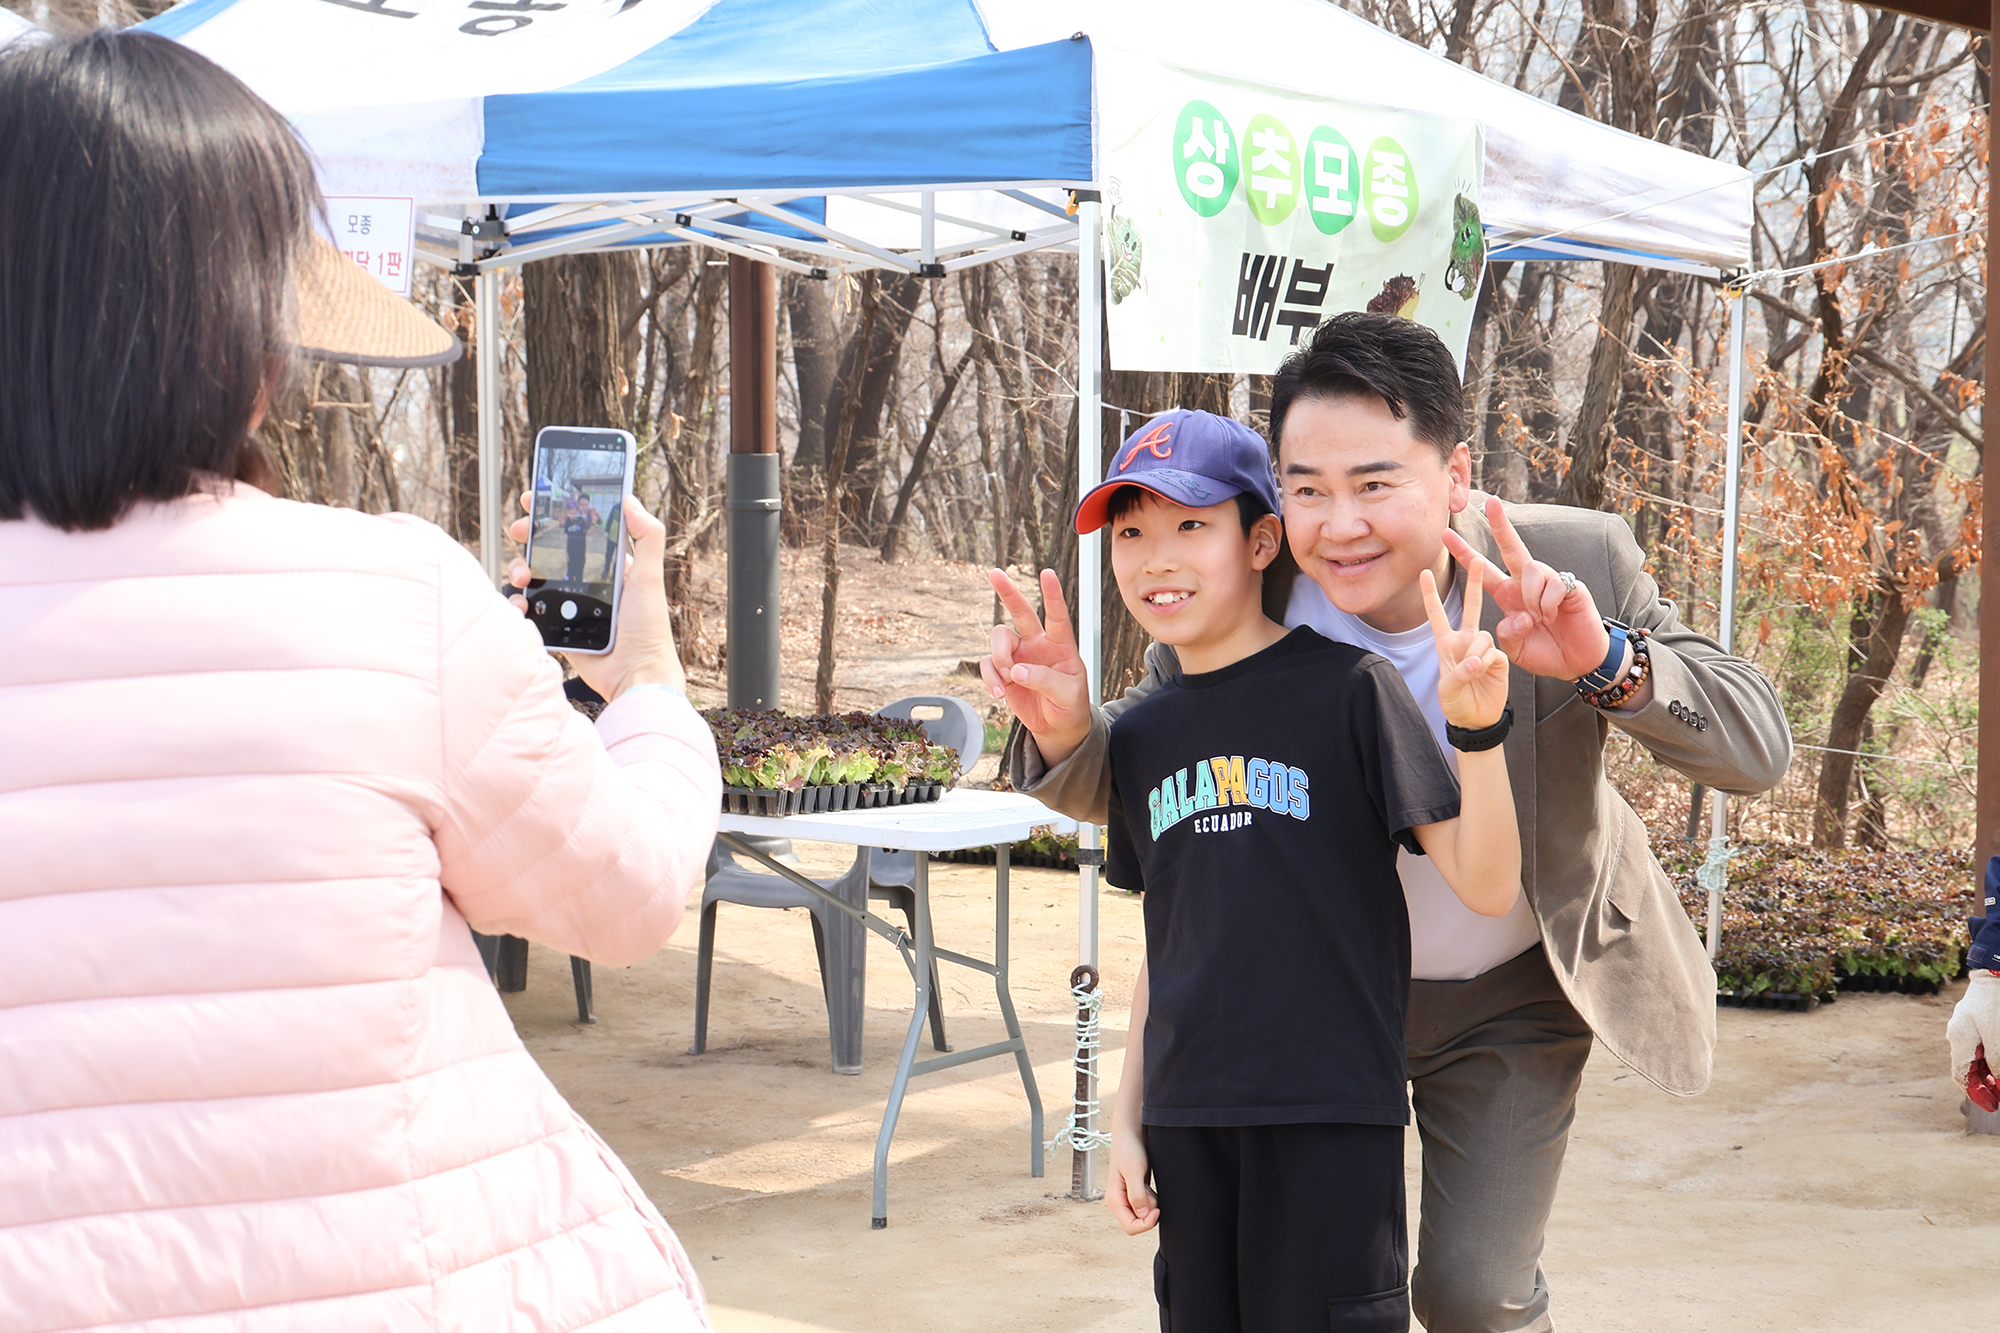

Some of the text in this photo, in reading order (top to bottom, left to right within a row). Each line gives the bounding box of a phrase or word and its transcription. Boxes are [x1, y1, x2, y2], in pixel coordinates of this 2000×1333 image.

[1182, 115, 1411, 228] 상추모종
[347, 214, 371, 235] 모종
[1231, 251, 1335, 346] 배부
[1119, 421, 1174, 471] A
[1148, 755, 1311, 842] GALAPAGOS
[1193, 811, 1254, 834] ECUADOR
